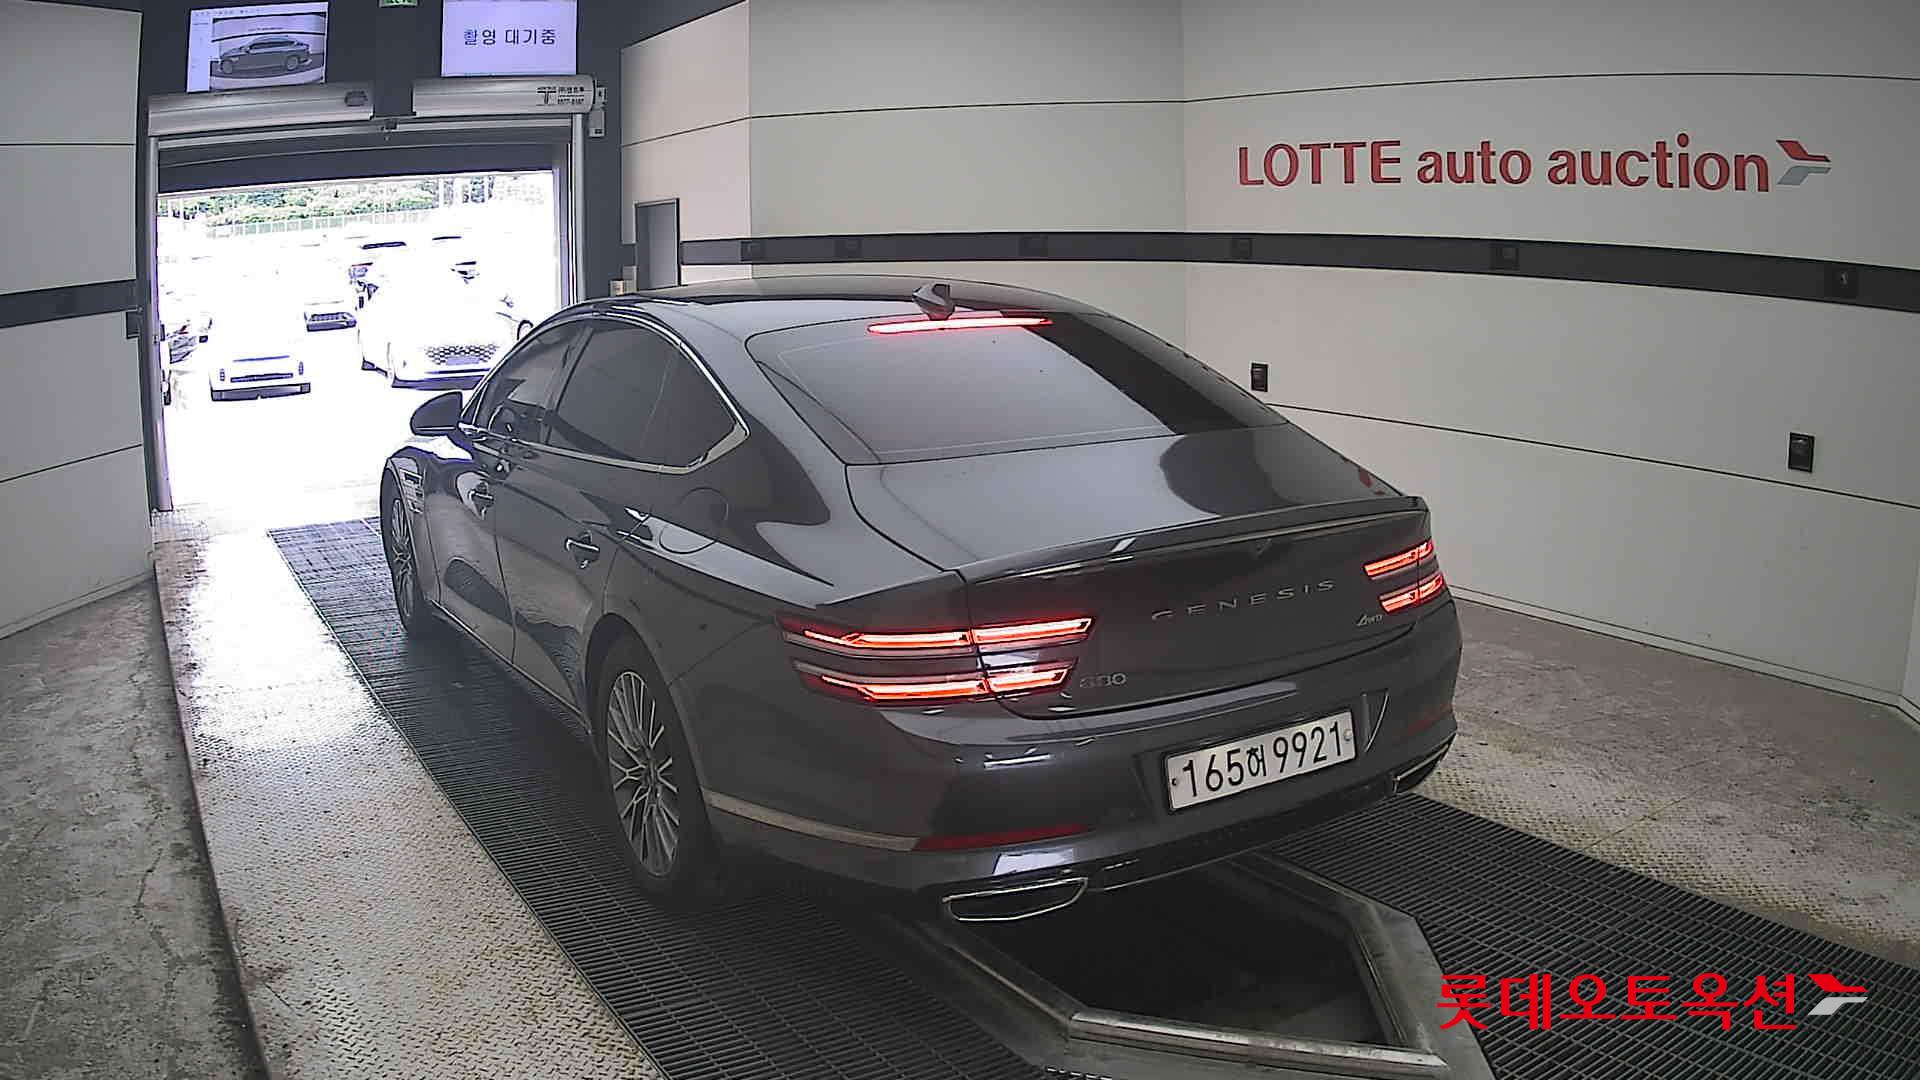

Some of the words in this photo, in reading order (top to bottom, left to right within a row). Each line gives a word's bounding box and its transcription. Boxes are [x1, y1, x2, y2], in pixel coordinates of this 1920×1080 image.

[504, 28, 556, 46] 대기중
[1239, 140, 1401, 186] LOTTE
[1416, 139, 1532, 186] auto
[1547, 132, 1769, 193] auction
[1151, 579, 1335, 621] GENESIS
